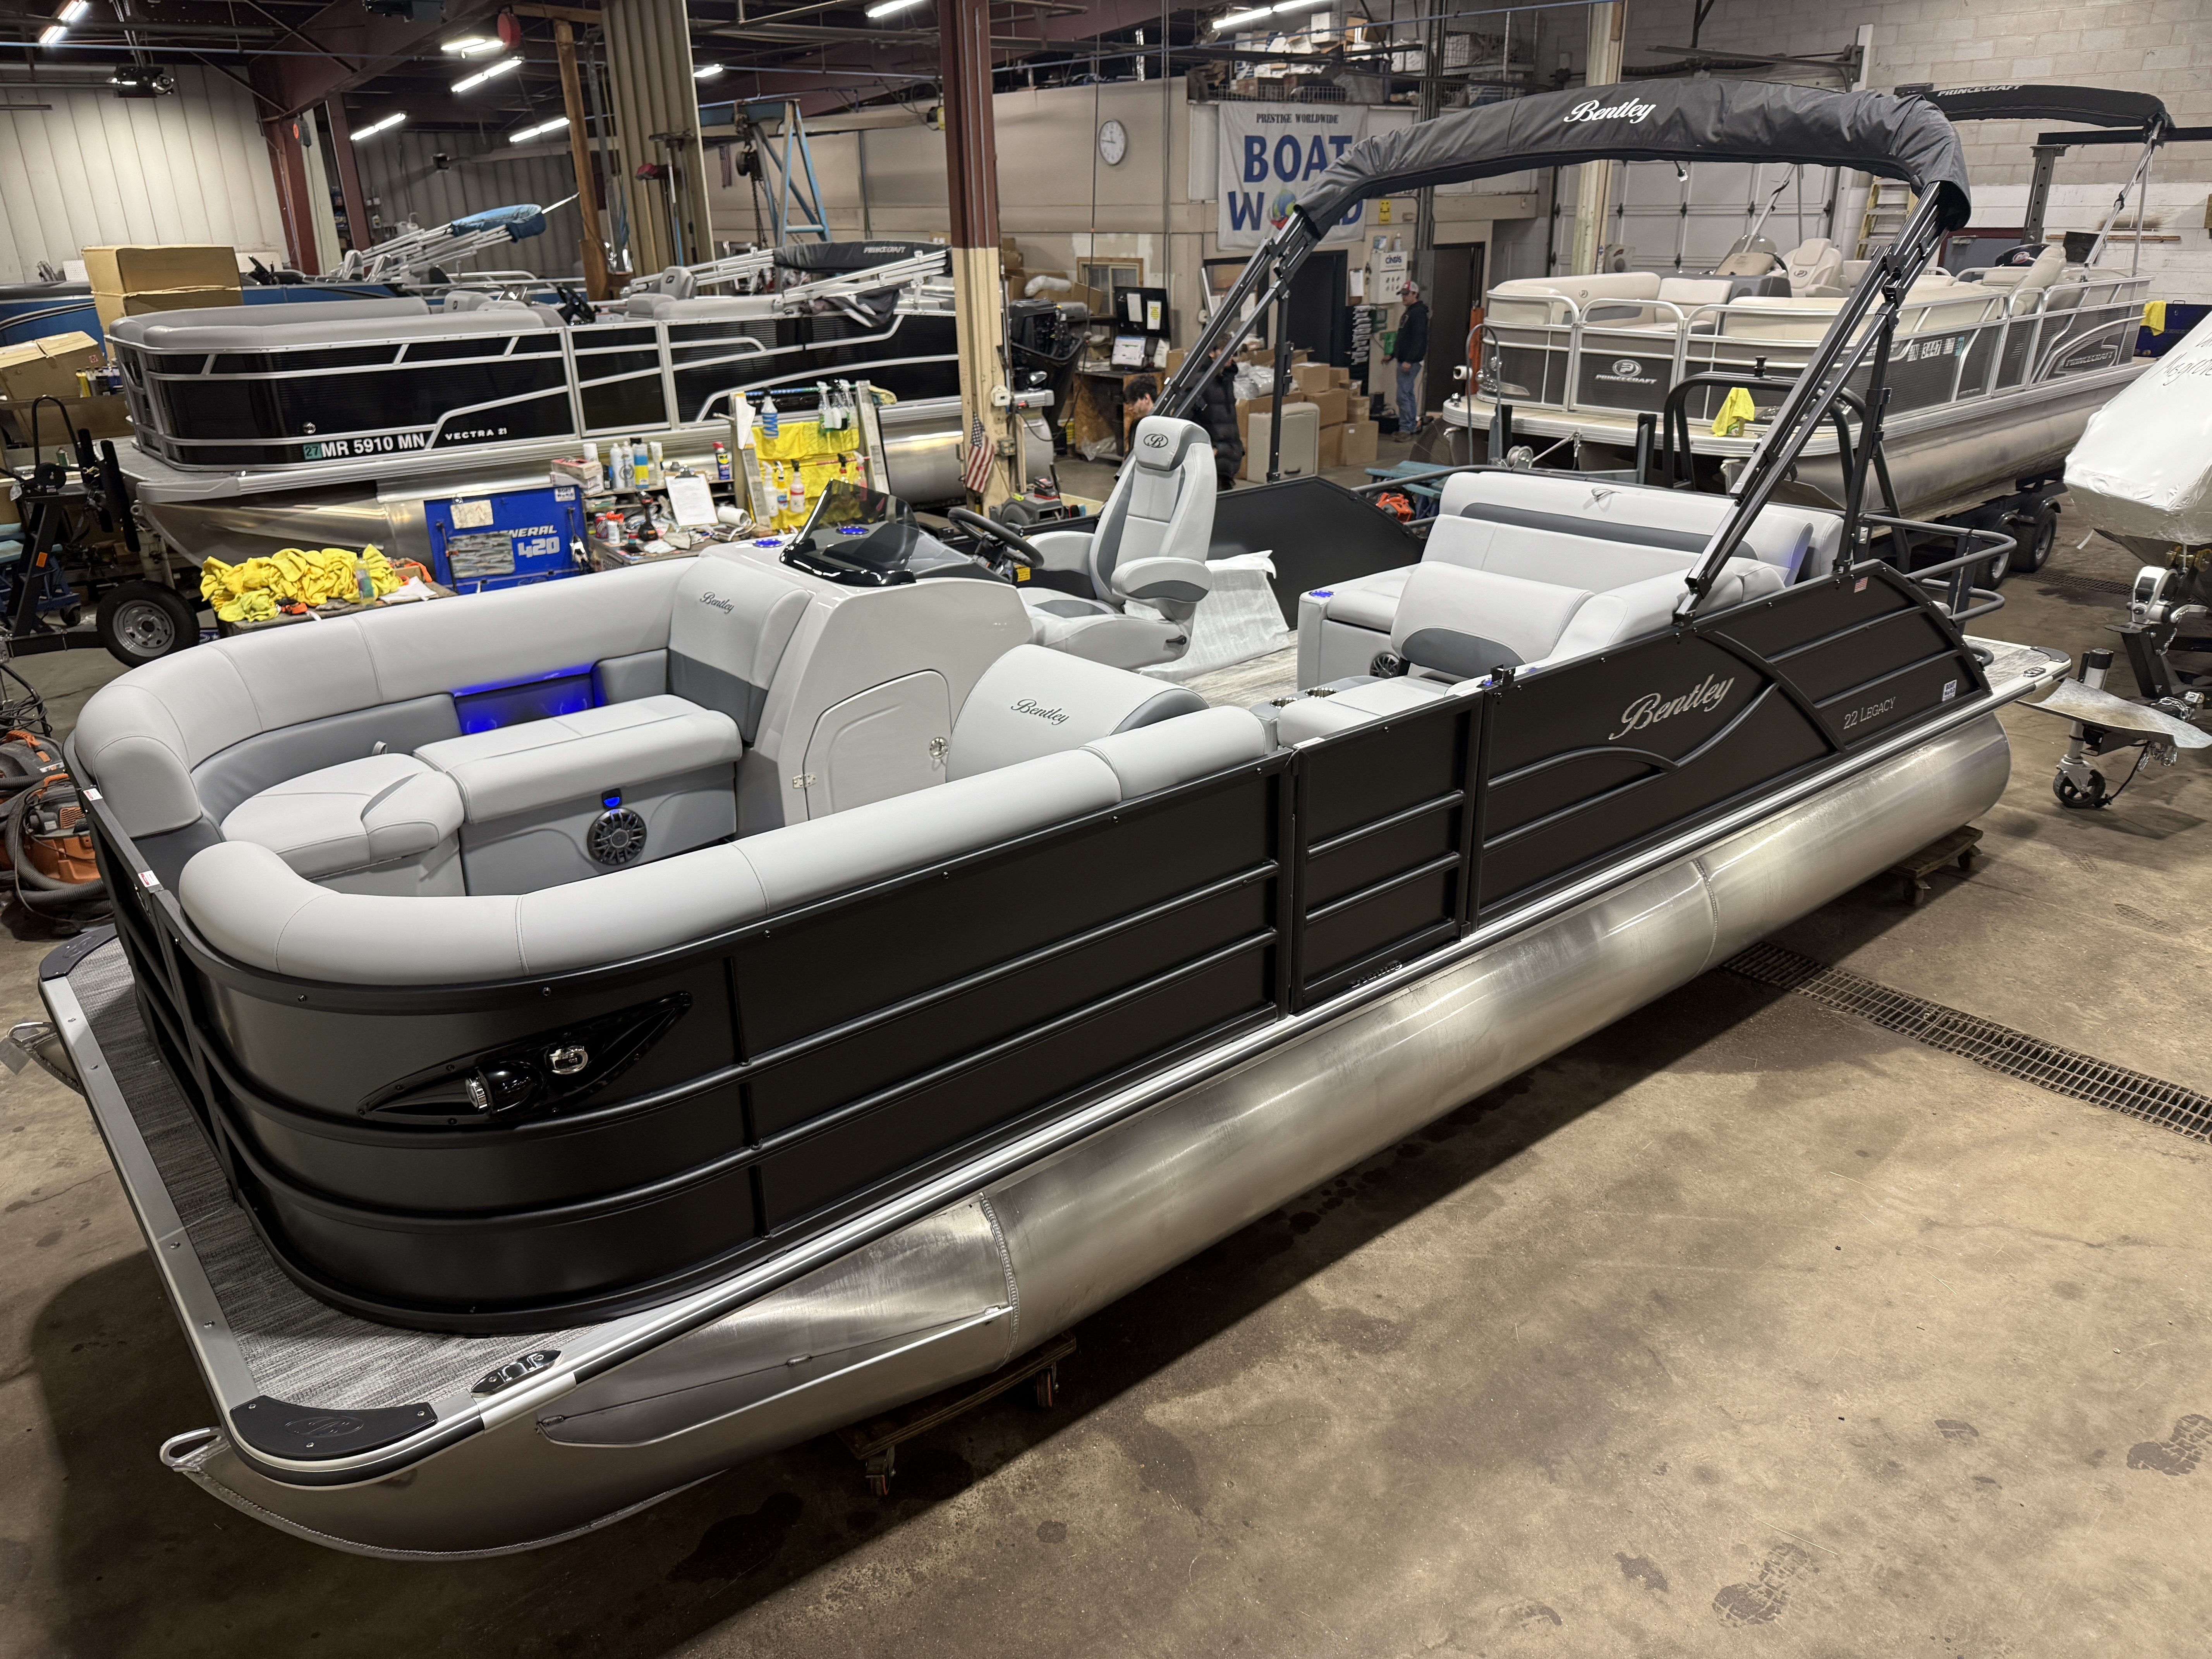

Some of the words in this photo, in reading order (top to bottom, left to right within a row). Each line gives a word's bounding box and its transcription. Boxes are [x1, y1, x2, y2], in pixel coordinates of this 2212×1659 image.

[1937, 84, 2024, 97] PRINCECRAFT
[1256, 113, 1292, 124] PRESTIGE
[1295, 114, 1339, 124] WORLDWIDE
[1563, 98, 1656, 124] Bentley
[1243, 134, 1353, 183] BOAT
[1595, 374, 1657, 385] PRINCECRAFT
[321, 441, 350, 458] MR
[353, 436, 393, 454] 5910
[397, 433, 425, 450] MN
[445, 429, 495, 441] VECTRA
[498, 427, 507, 435] 21
[305, 446, 319, 457] 27
[517, 536, 560, 558] 420
[700, 591, 735, 614] Bentley
[1011, 699, 1070, 725] Bentley
[1608, 673, 1735, 740] Bentley
[1844, 711, 1858, 730] 22
[1860, 696, 1896, 722] LEGACY
